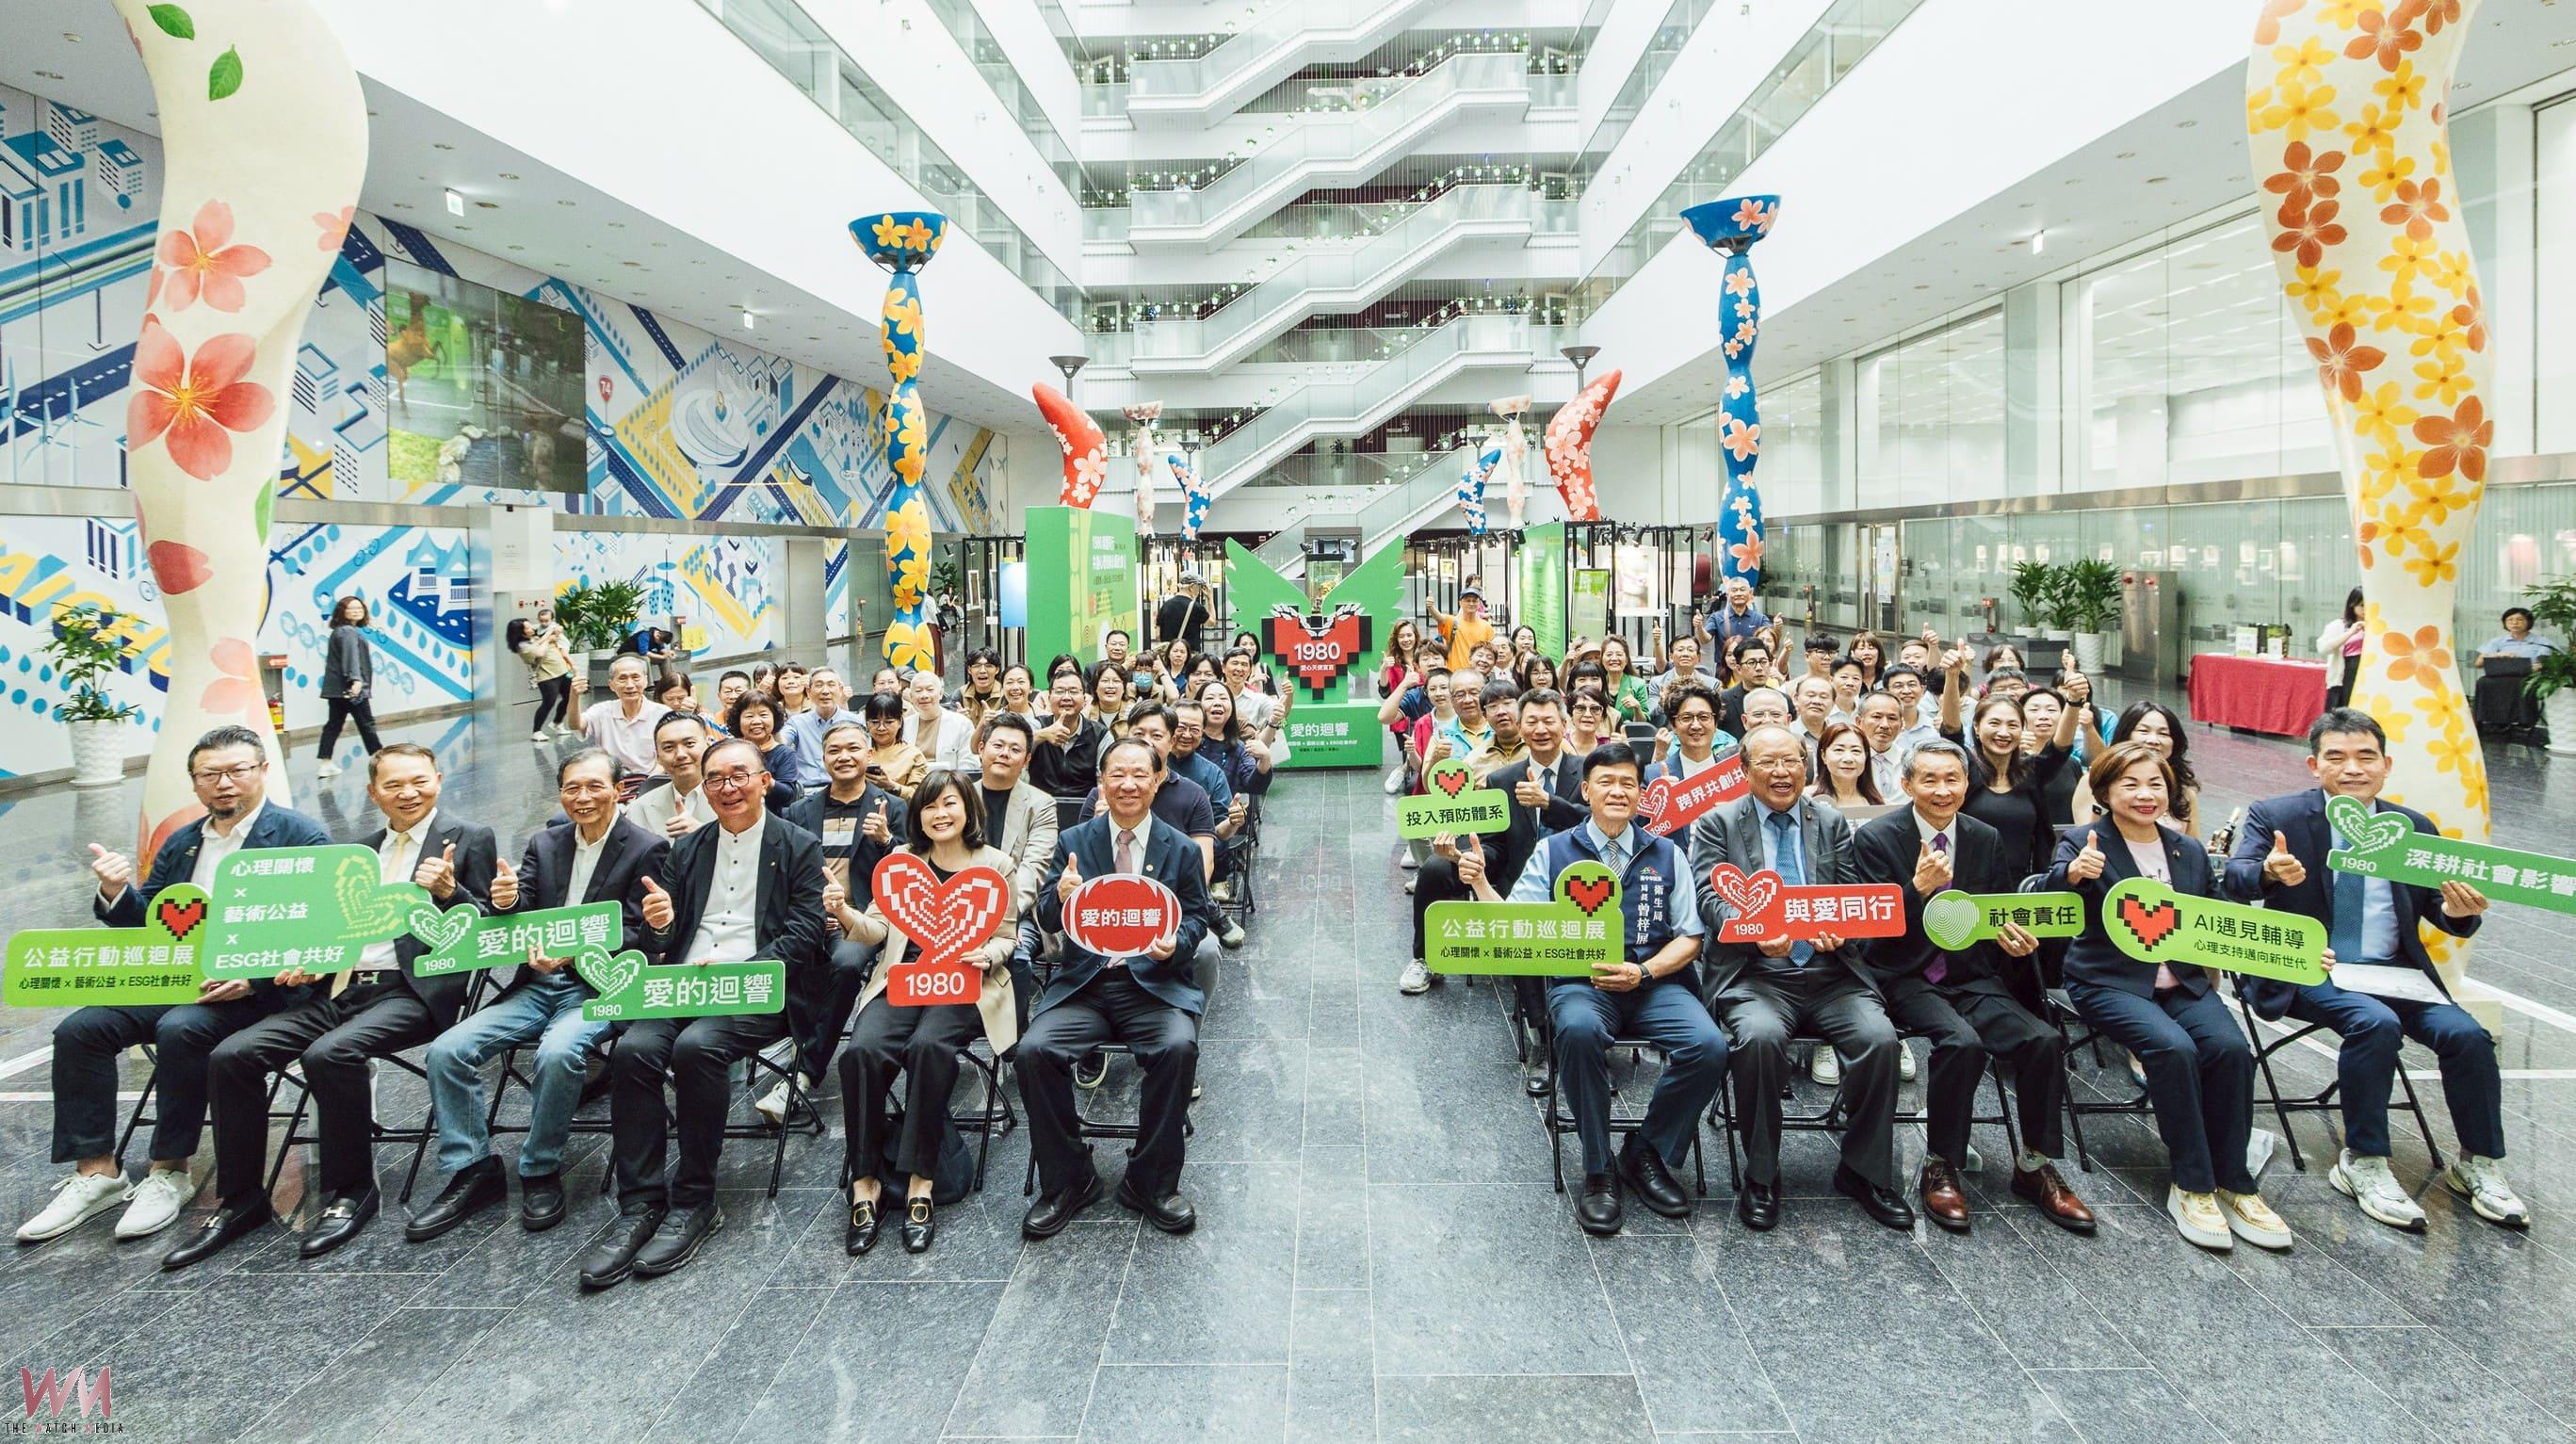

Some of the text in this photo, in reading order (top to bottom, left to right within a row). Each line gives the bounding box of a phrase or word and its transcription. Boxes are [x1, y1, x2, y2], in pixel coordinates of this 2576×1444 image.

[1293, 641, 1341, 661] 1980
[1290, 722, 1349, 738] 愛的迴響
[1406, 804, 1504, 826] 投入預防體系
[230, 856, 316, 877] 心理關懷
[2340, 856, 2377, 873] 1980
[222, 901, 309, 924] 藝術公益
[1653, 884, 1664, 921] 衛生局
[1784, 894, 1897, 924] 與愛同行
[1080, 908, 1161, 928] 愛的迴響
[1989, 906, 2077, 927] 社會責任
[477, 913, 611, 959] 愛的迴響
[1442, 919, 1606, 940] 公益行動巡迴展
[1733, 922, 1764, 935] 1980
[2195, 914, 2305, 949] AI遇見輔導
[24, 945, 194, 968] 公益行動巡迴展
[215, 945, 346, 969] ESG社會共好
[1440, 946, 1480, 959] 心理關懷
[1493, 947, 1532, 959] 藝術公益
[1545, 948, 1607, 960] ESG社會共好
[2194, 939, 2308, 970] 心理支持邁向新世代
[424, 957, 456, 971] 1980
[19, 977, 61, 989] 心理關懷
[74, 976, 117, 989] 藝術公益
[128, 974, 193, 987] ESG社會共好
[643, 973, 774, 1009] 愛的迴響
[905, 971, 965, 997] 1980
[591, 1004, 623, 1017] 1980
